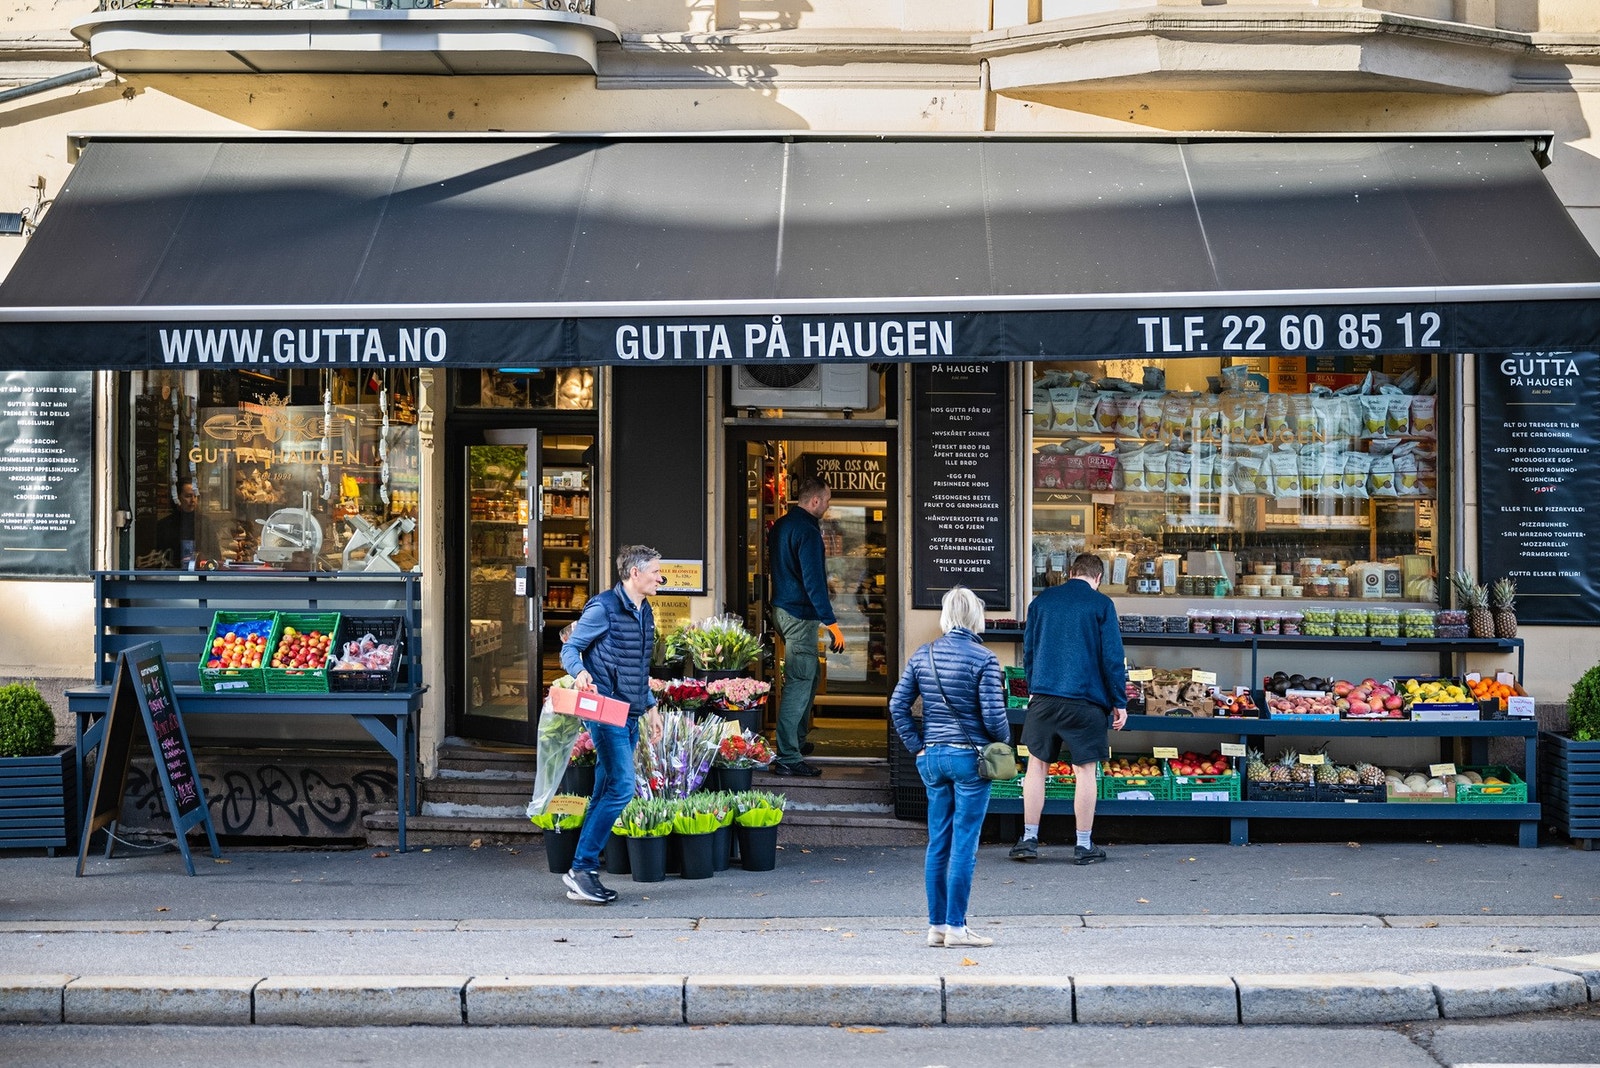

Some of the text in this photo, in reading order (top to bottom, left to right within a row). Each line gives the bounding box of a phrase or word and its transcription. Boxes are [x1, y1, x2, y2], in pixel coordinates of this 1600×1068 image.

[615, 315, 953, 360] GUTTA PÅ HAUGEN
[1137, 312, 1441, 352] TLF. 22 60 85 12
[159, 327, 447, 363] WWW.GUTTA.NO
[931, 363, 989, 373] PÅ HAUGEN
[1500, 359, 1580, 376] GUTTA
[9, 385, 21, 393] GÅR
[1510, 376, 1573, 386] PÅ HAUGEN
[1142, 427, 1215, 443] GUTTA
[1231, 427, 1327, 444] HAUGEN
[188, 448, 360, 465] GUTTA HAUGEN
[816, 458, 880, 471] SPØR OSS OM
[651, 600, 660, 608] PÅ
